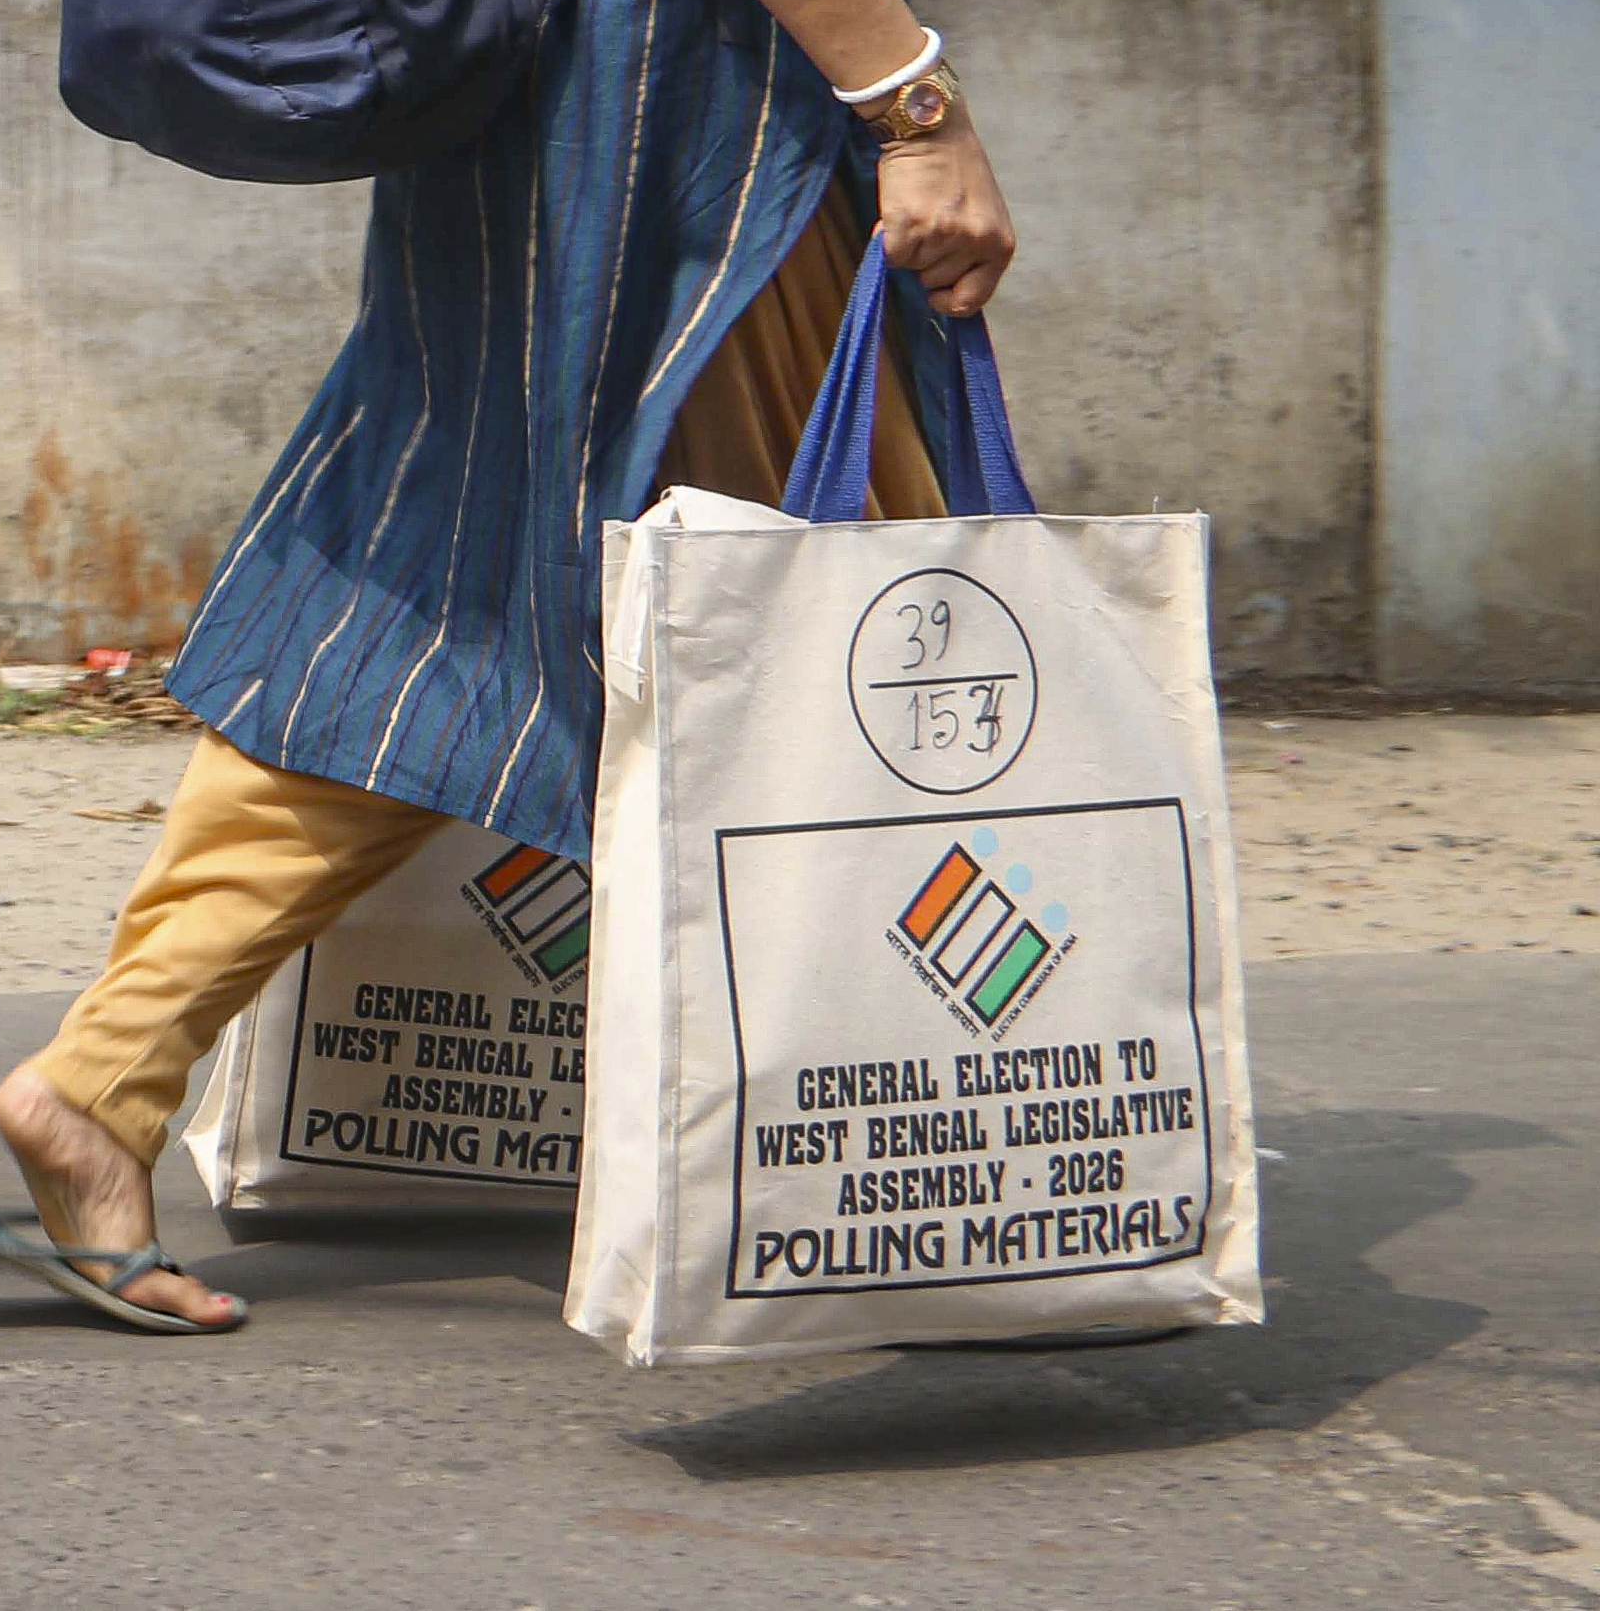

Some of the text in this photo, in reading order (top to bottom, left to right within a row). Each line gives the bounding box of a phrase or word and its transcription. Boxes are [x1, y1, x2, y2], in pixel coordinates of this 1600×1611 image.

[897, 599, 951, 669] 39
[355, 983, 586, 1038] GENERAL ELEC
[314, 1021, 400, 1064] WEST
[415, 1032, 533, 1079] BENGAL
[797, 1037, 1156, 1111] GENERAL ELECTION TO
[382, 1073, 547, 1122] ASSEMBLY
[756, 1087, 1194, 1166] WEST BENGAL LEGISLATIVE
[304, 1107, 480, 1165] POLLING
[837, 1160, 1005, 1215] ASSEMBLY
[1048, 1149, 1123, 1197] 2026
[754, 1195, 1194, 1279] POLLING MATERIALS
